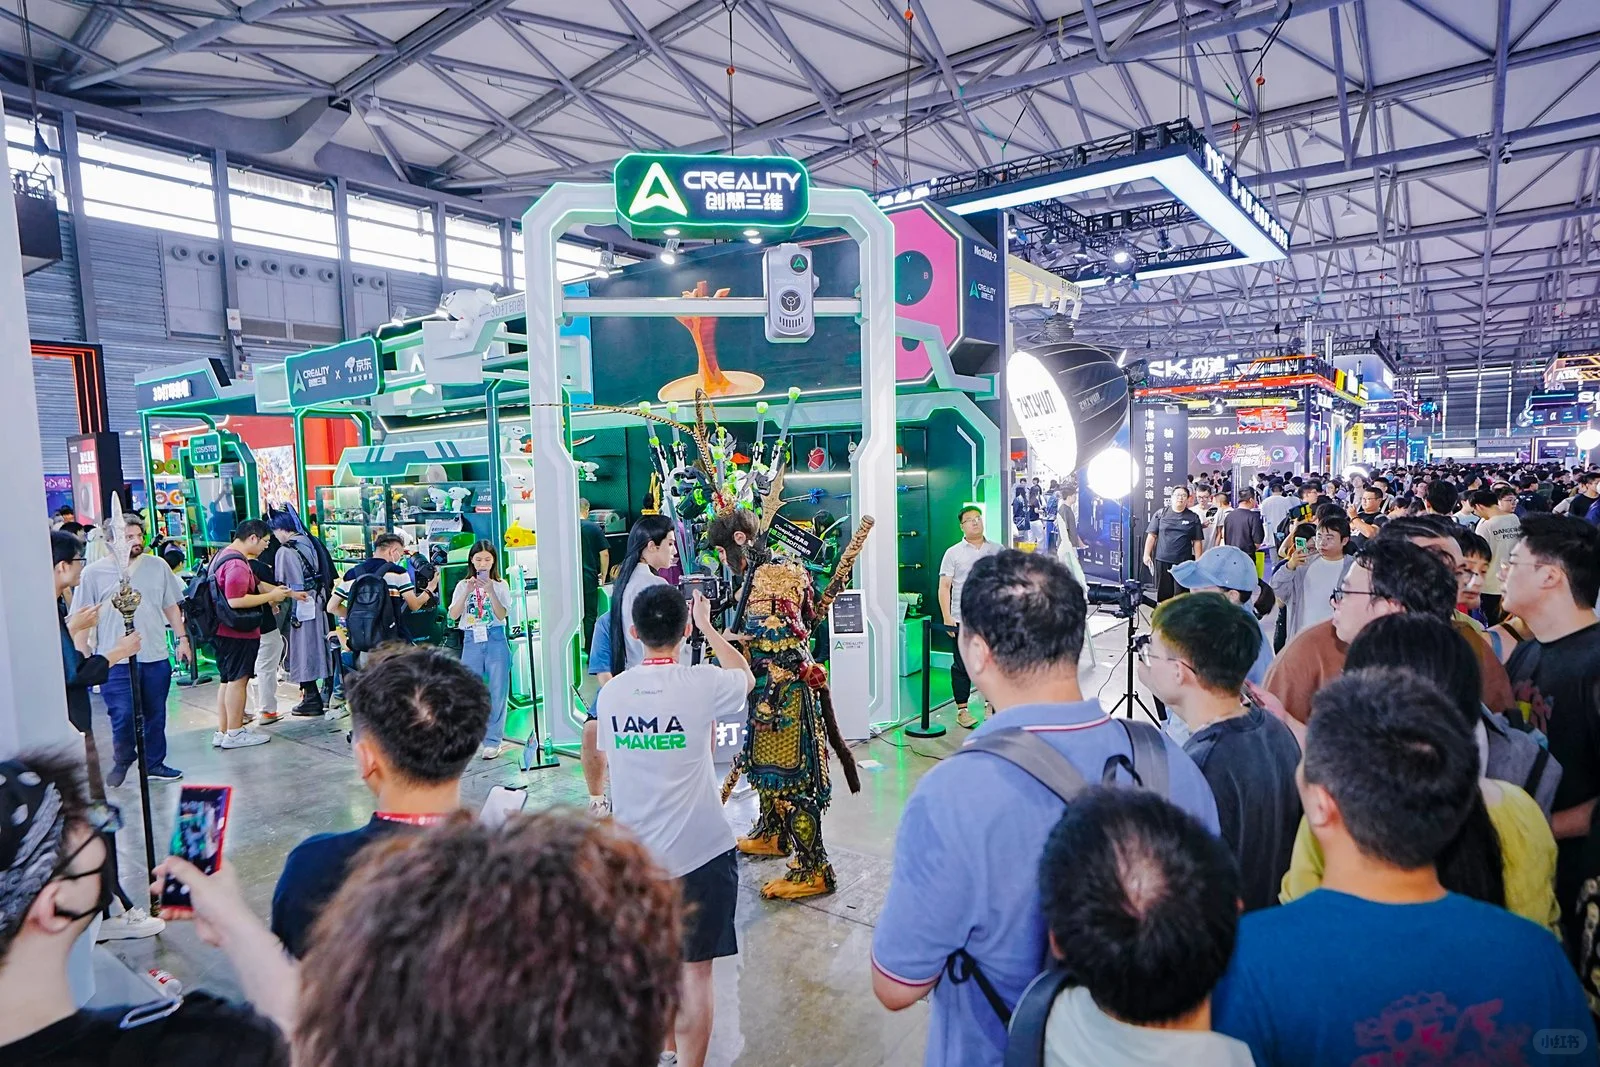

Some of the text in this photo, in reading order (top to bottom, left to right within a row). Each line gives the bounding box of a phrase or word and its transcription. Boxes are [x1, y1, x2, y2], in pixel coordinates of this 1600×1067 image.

[683, 171, 801, 191] CREALITY
[705, 192, 784, 211] 创想三维
[905, 255, 911, 263] Y
[977, 283, 996, 295] CREALITY
[303, 365, 330, 379] CREALITY
[355, 357, 372, 372] 京东
[611, 715, 685, 733] I AM A
[614, 733, 687, 750] MAKER
